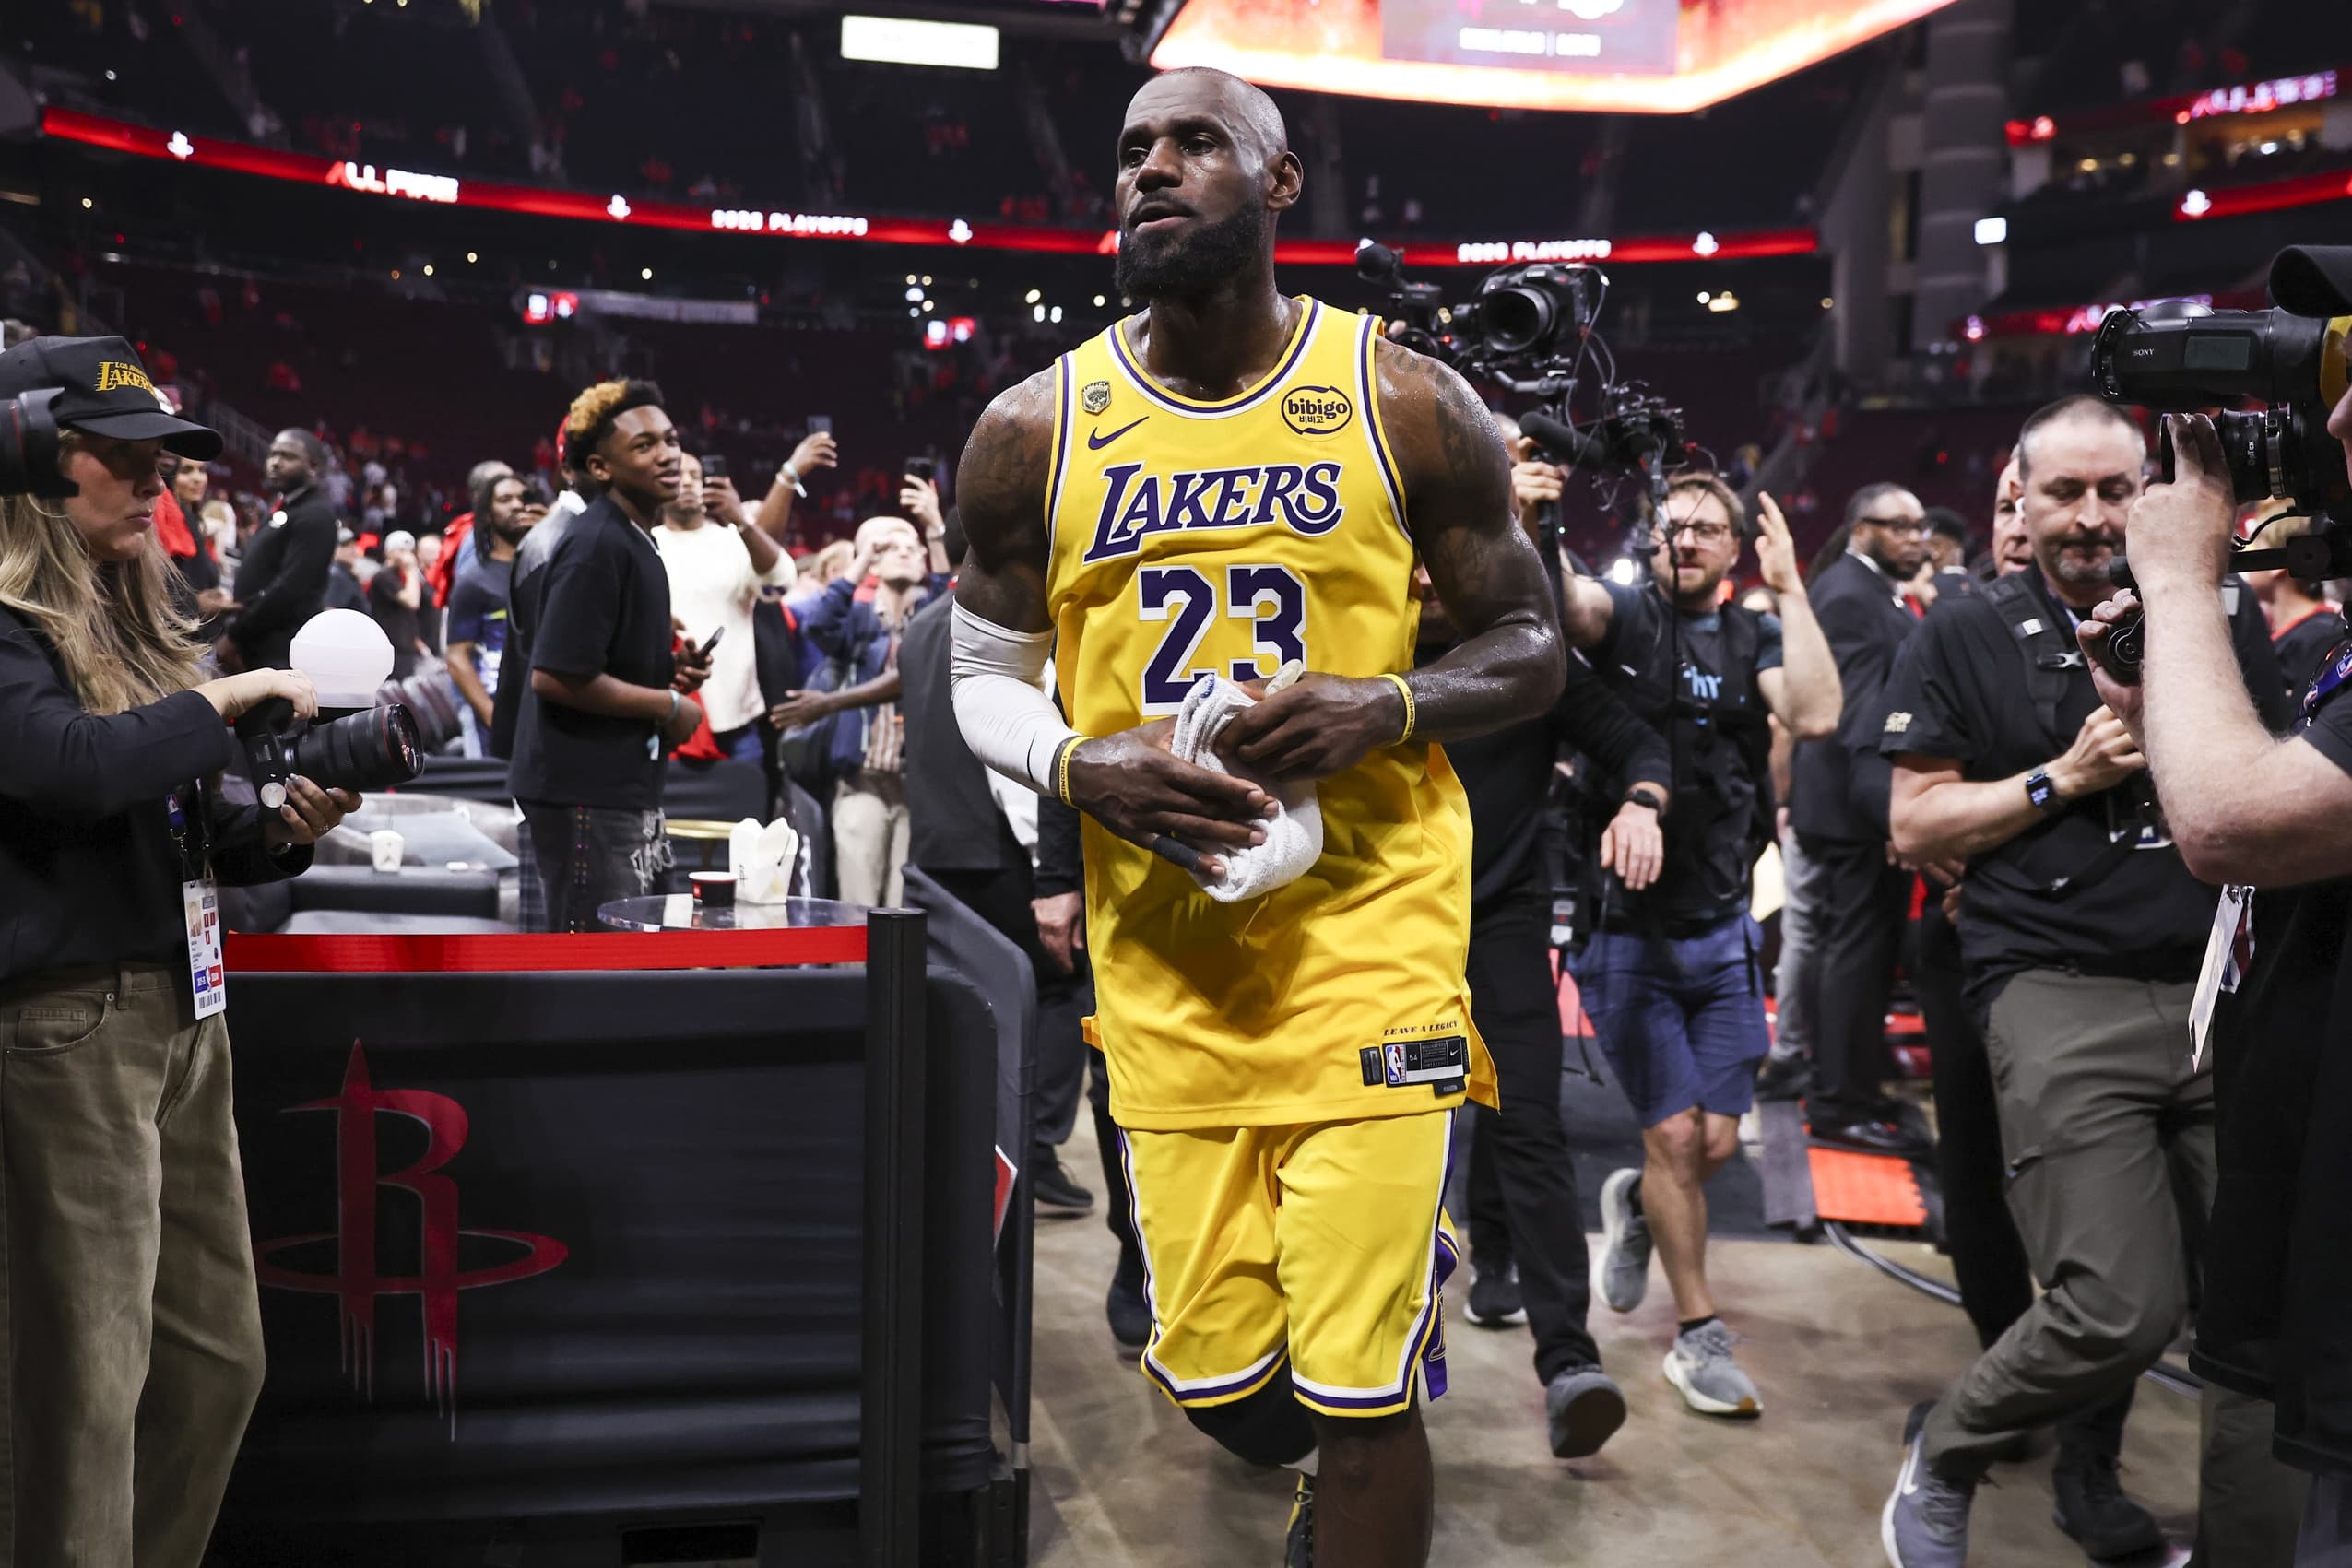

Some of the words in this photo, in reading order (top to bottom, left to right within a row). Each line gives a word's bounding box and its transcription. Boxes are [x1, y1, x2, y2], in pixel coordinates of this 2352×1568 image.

[325, 161, 385, 193] ALL
[1288, 398, 1348, 419] bibigo
[1299, 415, 1324, 425] 비비고
[1083, 461, 1345, 565] LAKERS
[1138, 564, 1306, 716] 23
[1384, 1025, 1417, 1036] LEAVE
[1429, 1020, 1457, 1032] LEGACY
